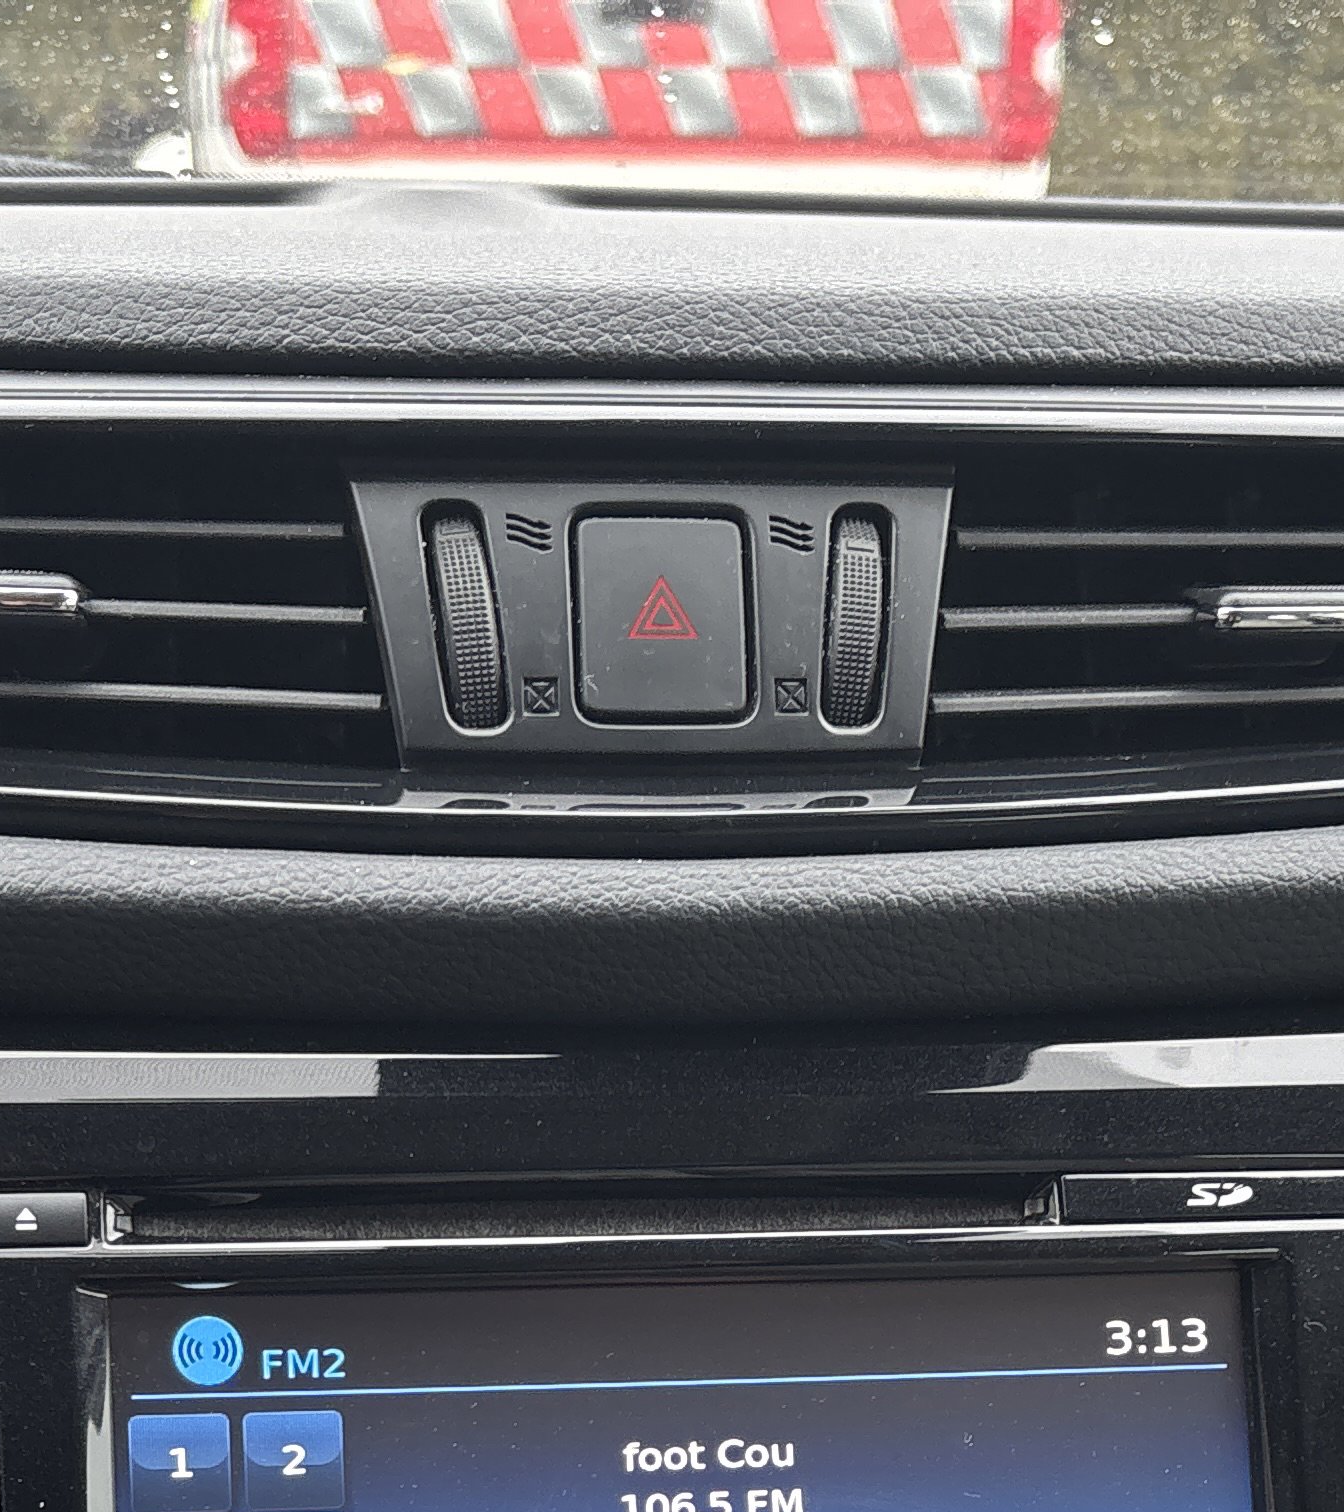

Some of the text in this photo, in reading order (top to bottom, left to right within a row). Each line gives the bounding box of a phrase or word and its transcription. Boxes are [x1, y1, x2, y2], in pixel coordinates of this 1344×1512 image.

[1105, 1317, 1209, 1356] 3:13
[261, 1348, 346, 1380] FM2
[169, 1447, 194, 1479] 1
[281, 1444, 307, 1477] 2
[623, 1438, 795, 1472] foot Cou
